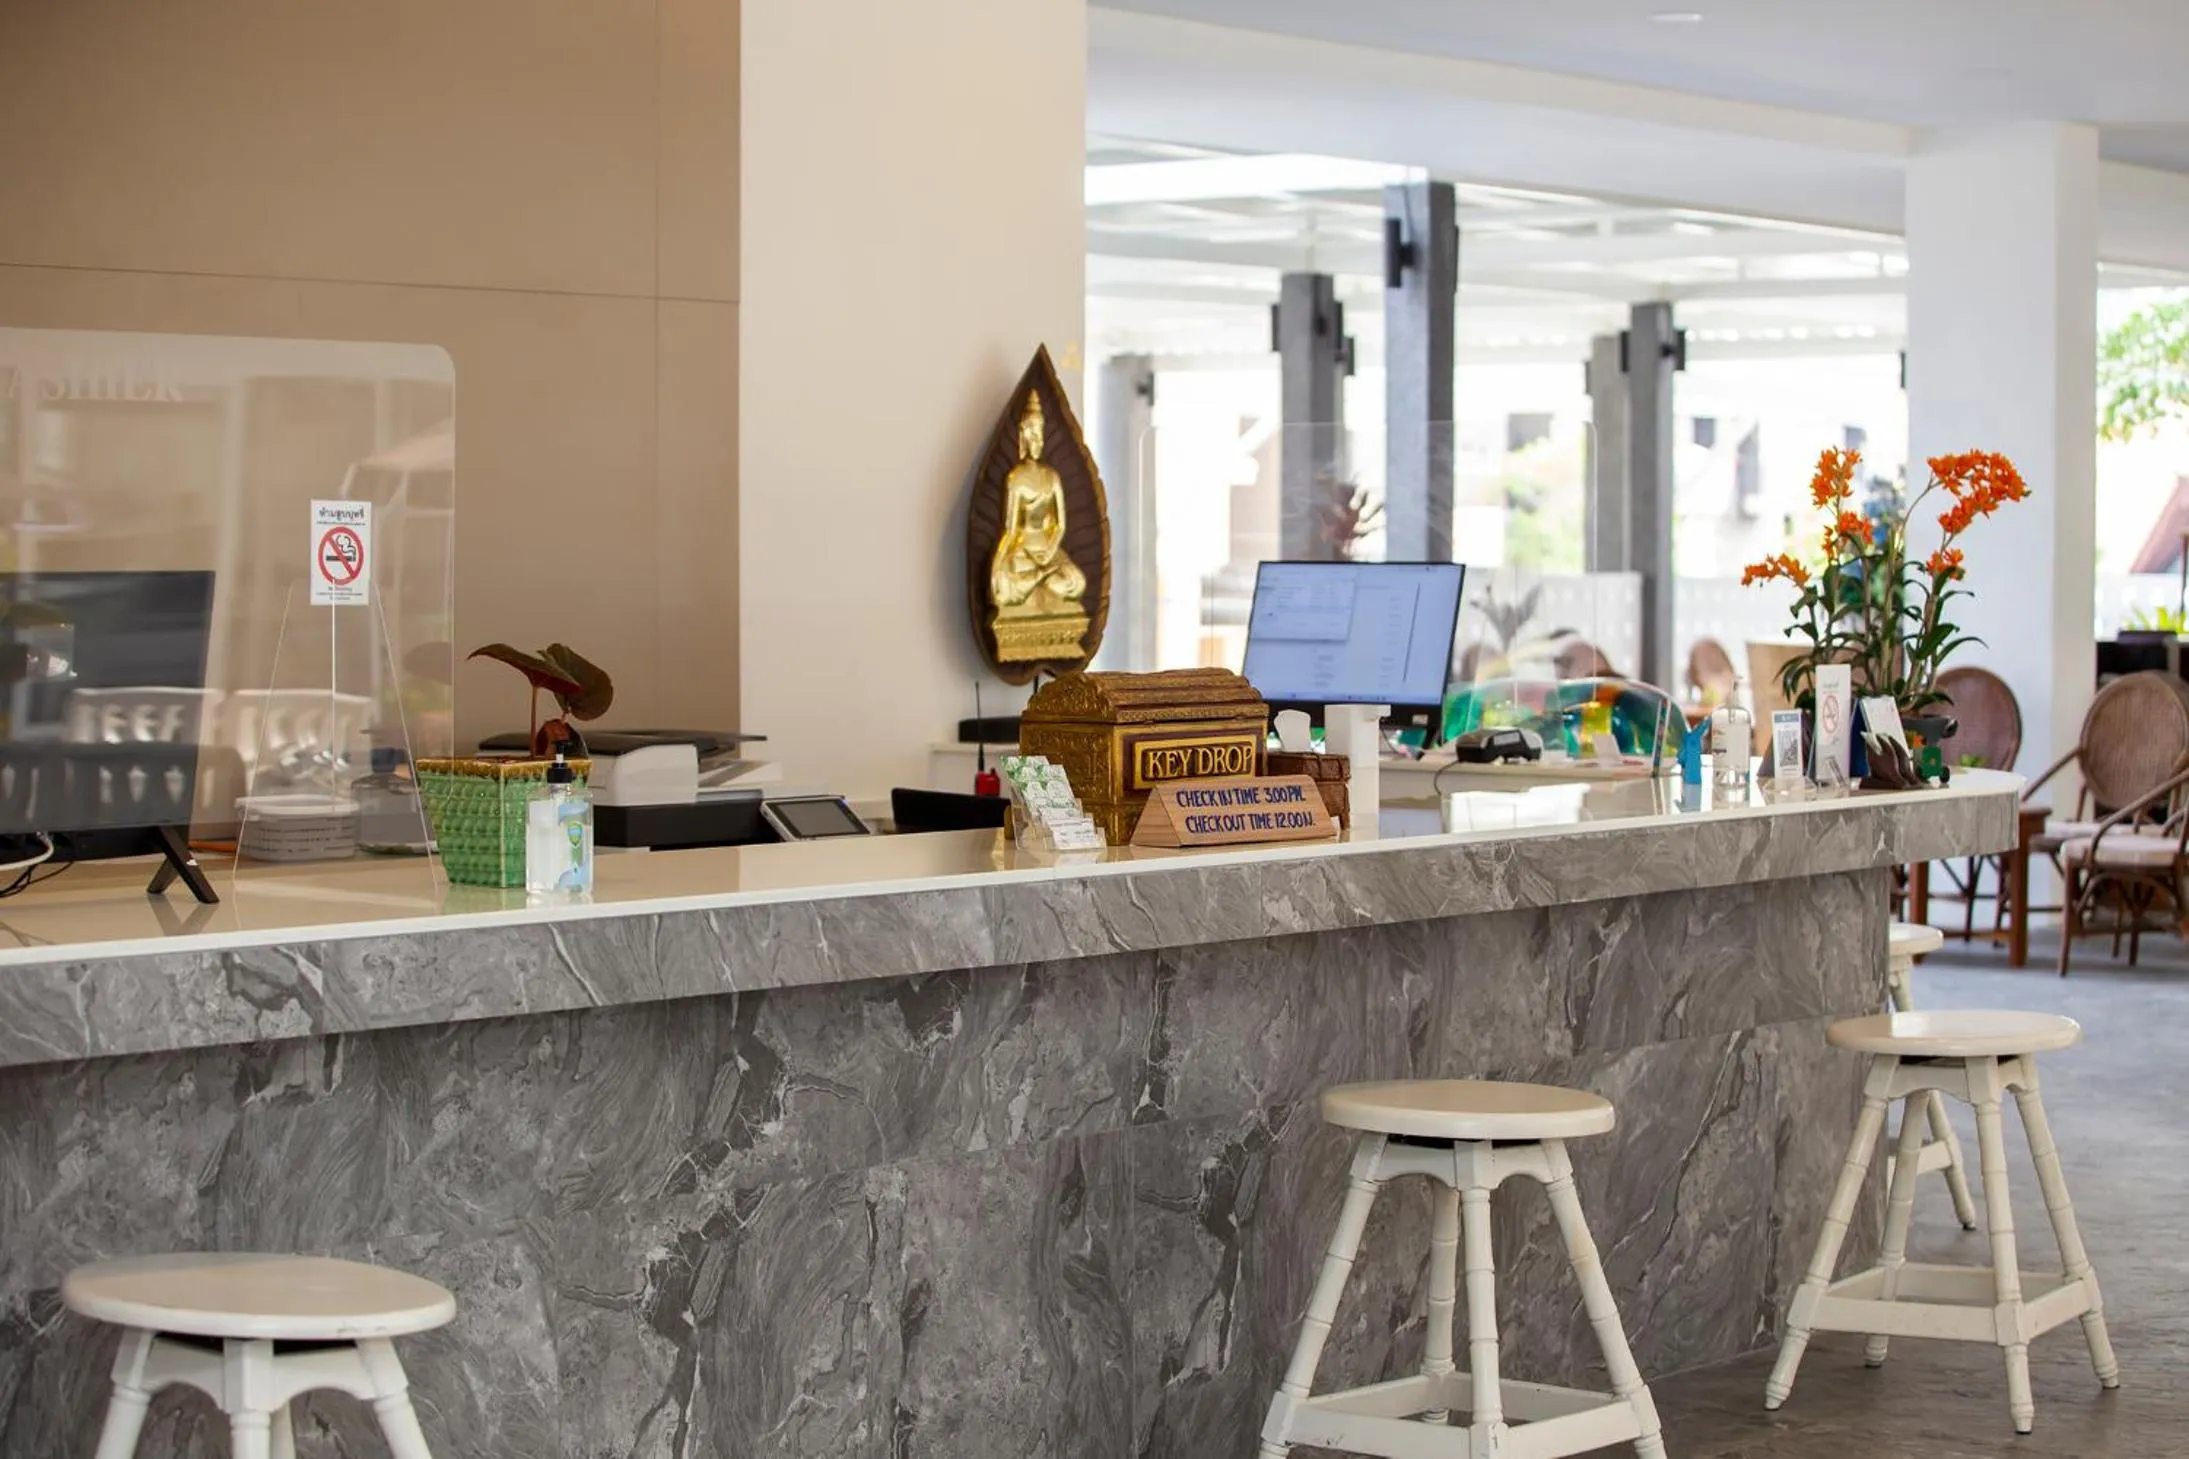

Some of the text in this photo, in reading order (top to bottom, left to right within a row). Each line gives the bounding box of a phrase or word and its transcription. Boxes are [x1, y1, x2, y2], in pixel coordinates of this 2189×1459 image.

[1149, 745, 1253, 778] KEY DROP
[1176, 789, 1219, 808] CHECK
[1219, 788, 1233, 806] IN
[1233, 787, 1261, 804] TIME
[1185, 815, 1223, 834] CHECK
[1223, 813, 1246, 832] OUT
[1248, 812, 1274, 830] TIME
